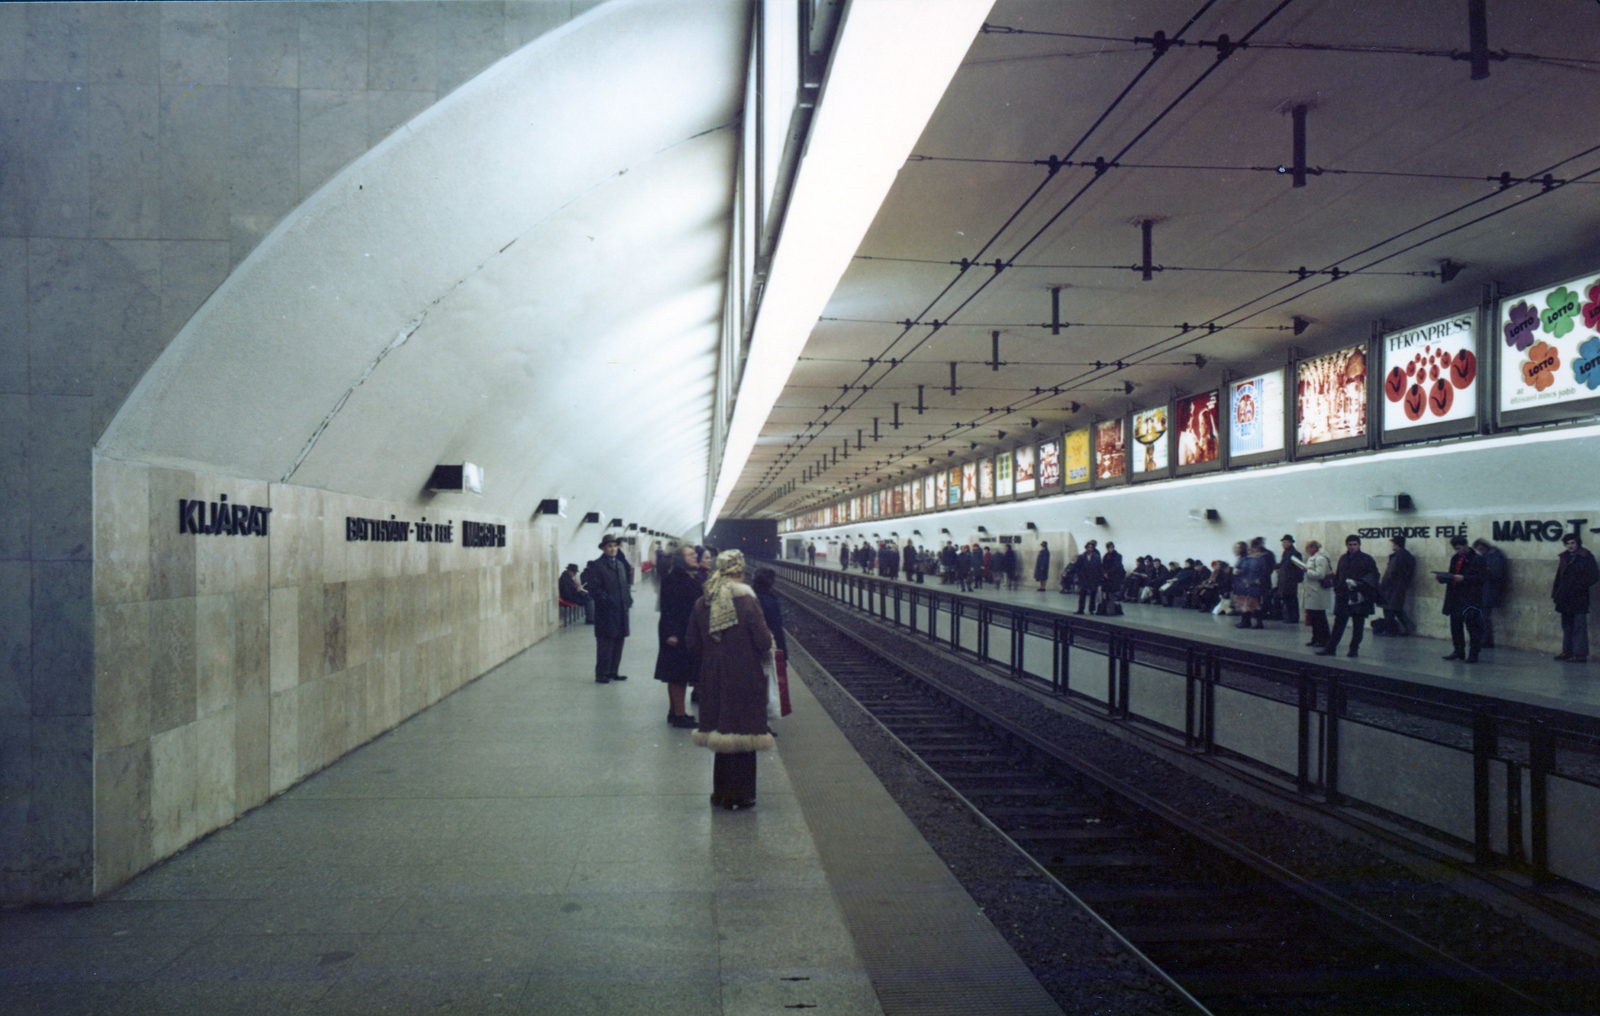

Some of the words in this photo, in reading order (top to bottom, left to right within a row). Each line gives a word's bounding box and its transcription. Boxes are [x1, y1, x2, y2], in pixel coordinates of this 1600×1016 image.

[1547, 302, 1574, 324] LOTTO
[1510, 316, 1534, 338] LOTTO
[1528, 356, 1554, 377] LOTTO
[1558, 387, 1576, 399] jobb
[179, 493, 272, 536] KIJÁRAT
[1357, 526, 1430, 539] SZENTENDRE
[1435, 521, 1468, 538] FELÉ
